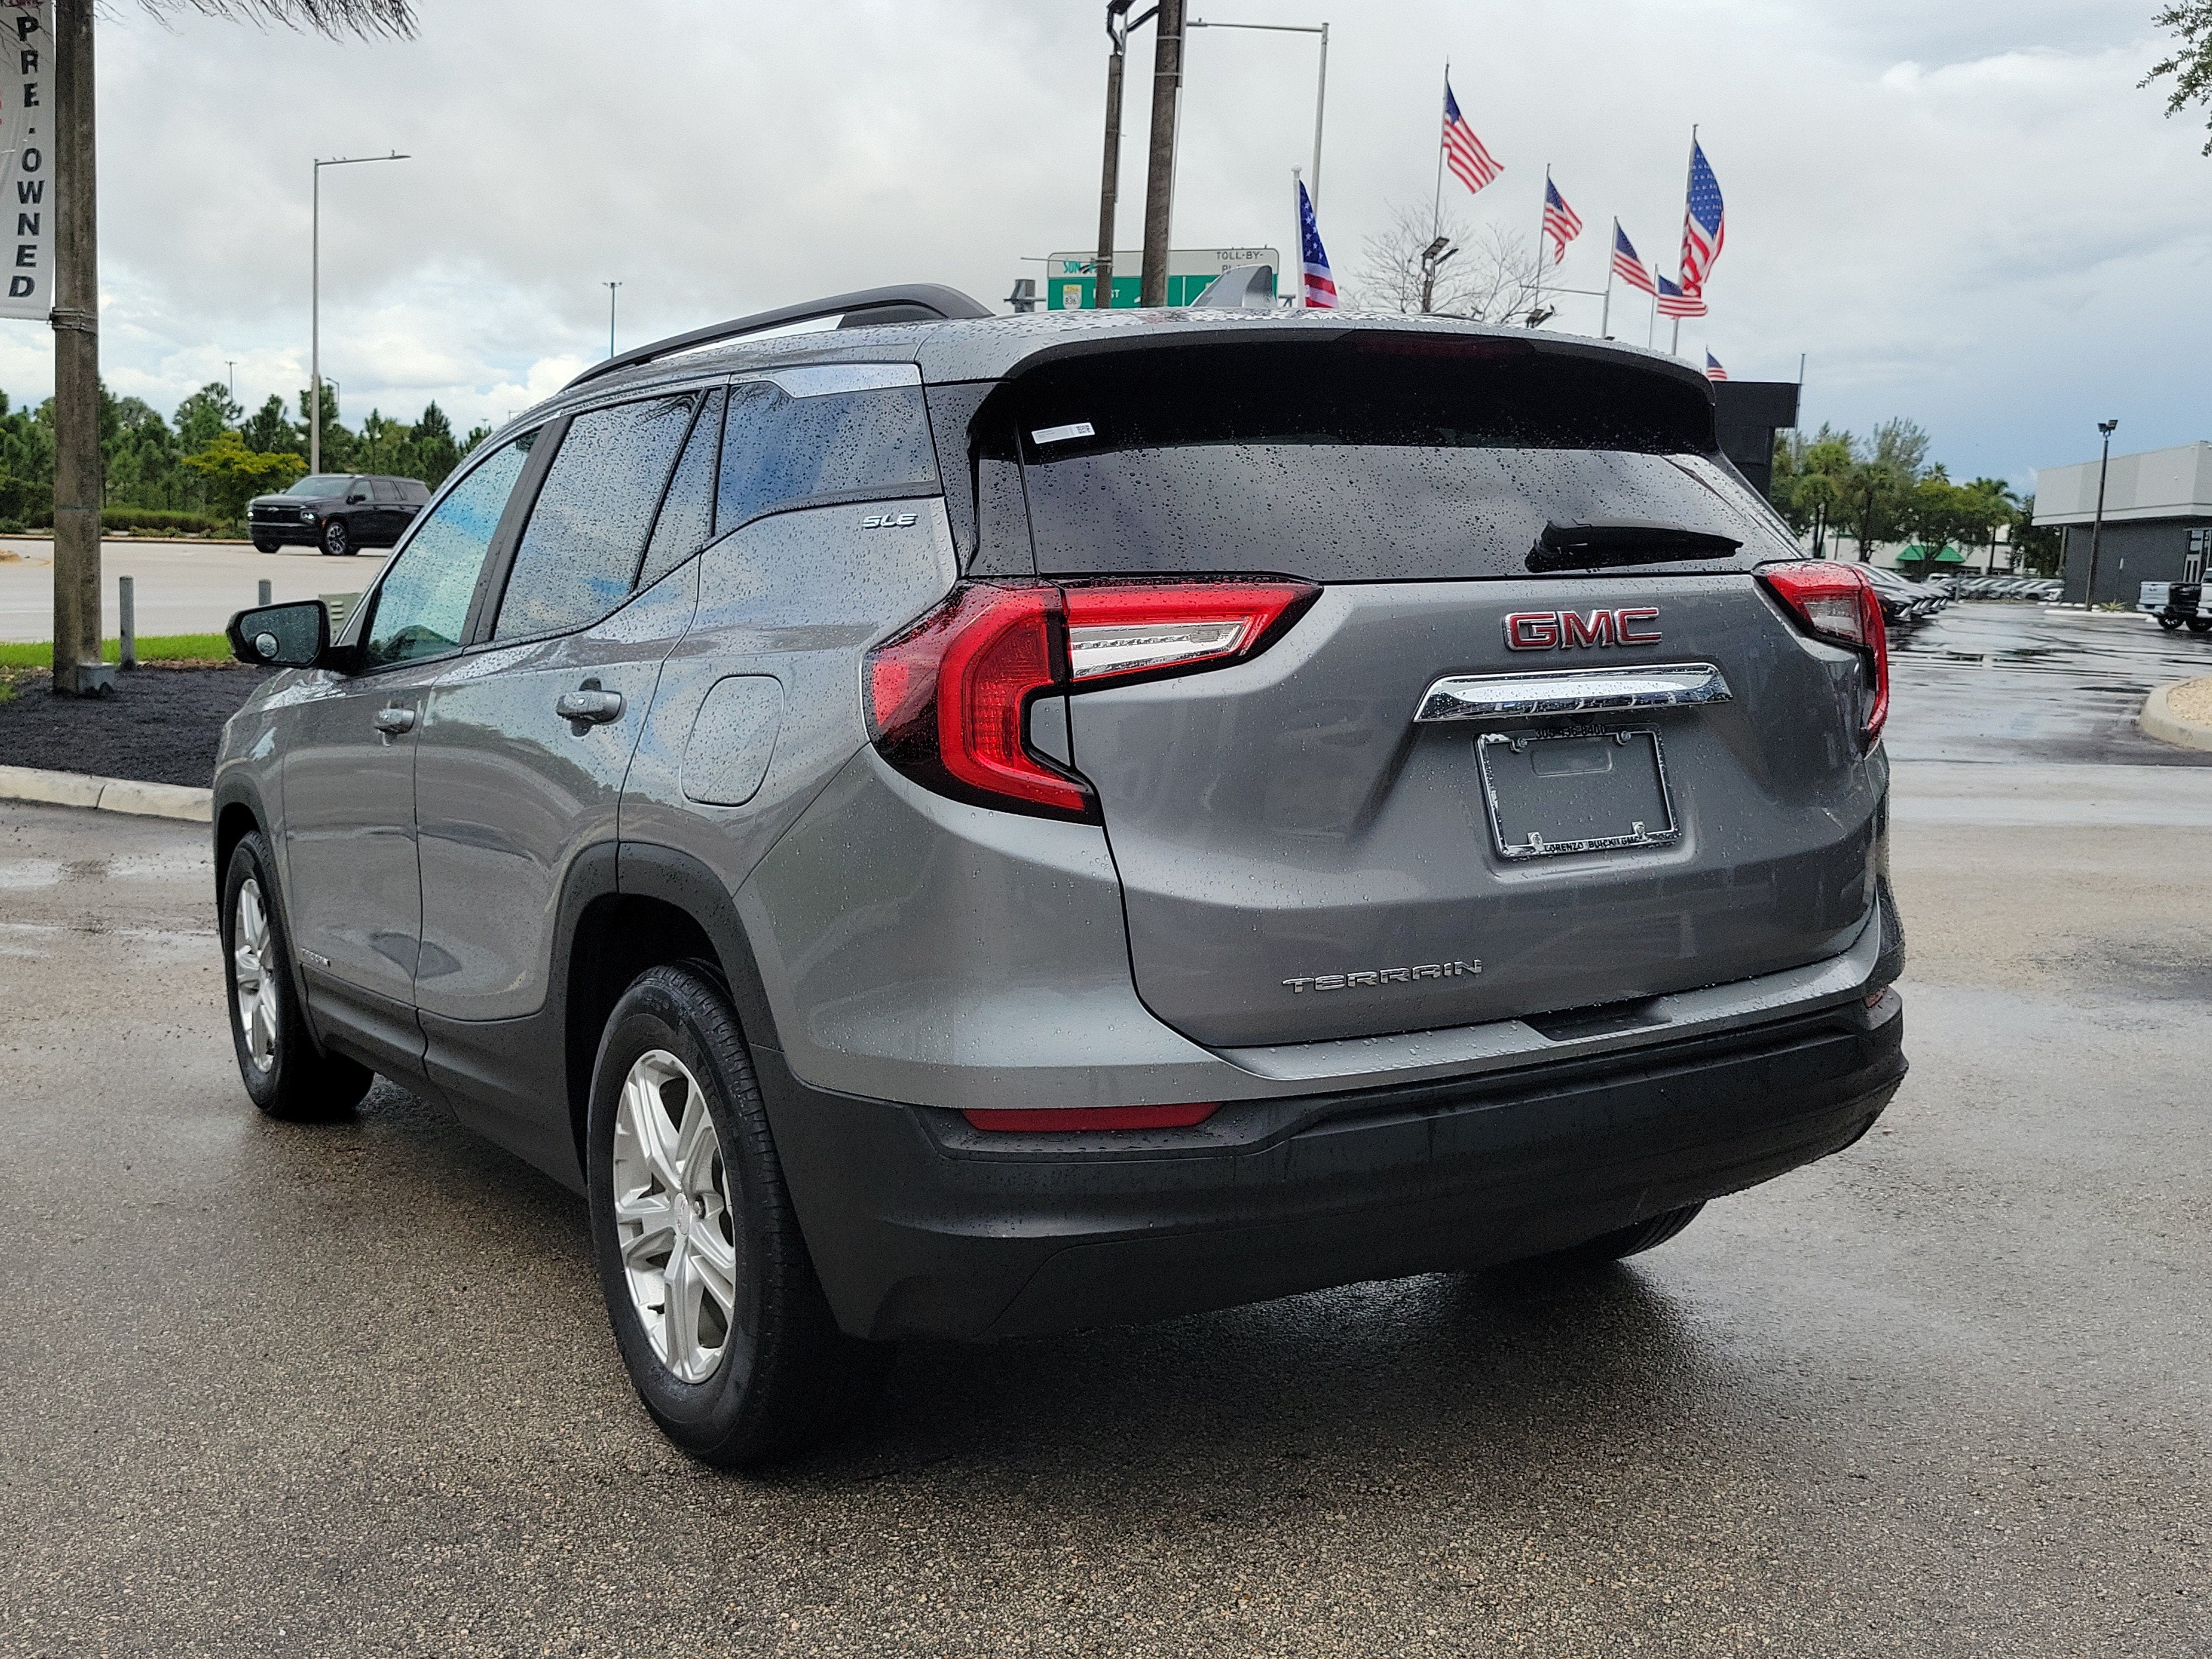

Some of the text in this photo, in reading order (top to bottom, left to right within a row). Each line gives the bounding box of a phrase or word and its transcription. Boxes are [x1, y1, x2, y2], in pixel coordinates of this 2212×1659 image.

[1216, 251, 1263, 260] TOLL-BY-
[862, 513, 918, 529] SLE
[1503, 607, 1662, 651] GMC
[1544, 841, 1584, 853] LORENZO
[1588, 838, 1615, 849] BUICK
[1282, 959, 1482, 993] TERRAIN
